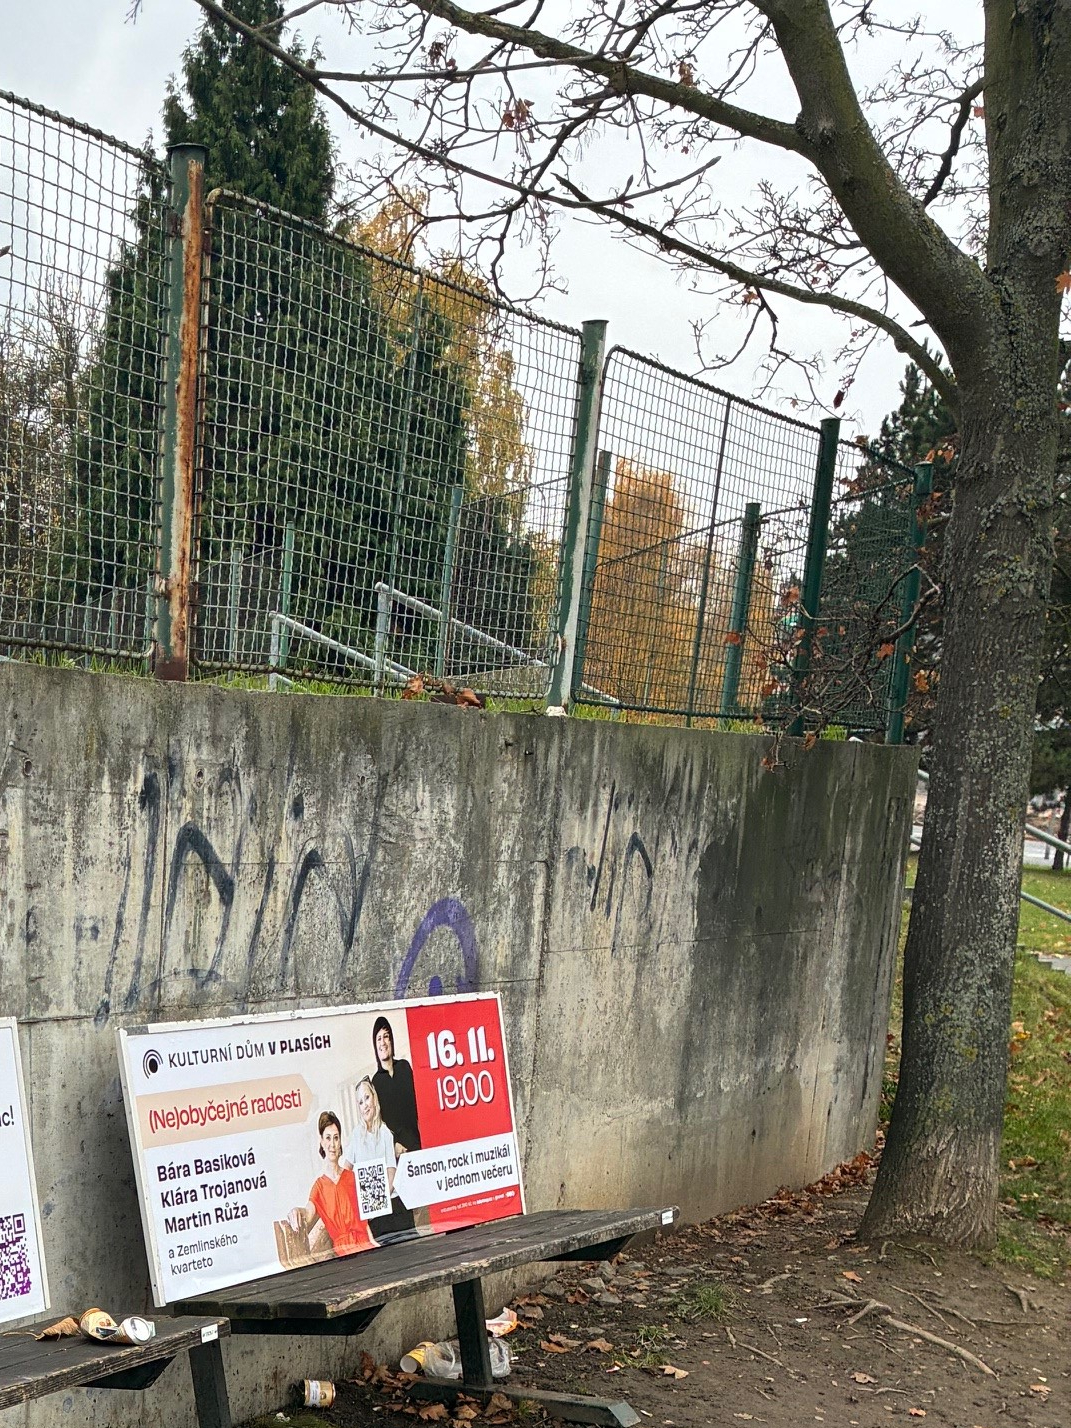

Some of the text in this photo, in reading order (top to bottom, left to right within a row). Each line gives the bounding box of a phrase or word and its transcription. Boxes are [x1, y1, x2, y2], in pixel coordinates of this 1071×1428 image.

[168, 1033, 331, 1069] KULTURNÍ DŮM V PLASÍCH
[426, 1025, 495, 1070] 16. 11.
[436, 1069, 495, 1111] 19:00
[148, 1089, 303, 1134] (Ne)obyčejné radosti
[157, 1147, 256, 1182] Bára Basiková
[407, 1144, 511, 1178] Šanson, rock i muzikál
[436, 1164, 513, 1191] v jednom večeru
[160, 1170, 268, 1209] Klára Trojanová
[164, 1201, 249, 1235] Martin Růža
[168, 1233, 239, 1259] a Zemlinského
[170, 1256, 214, 1276] kvarteto
